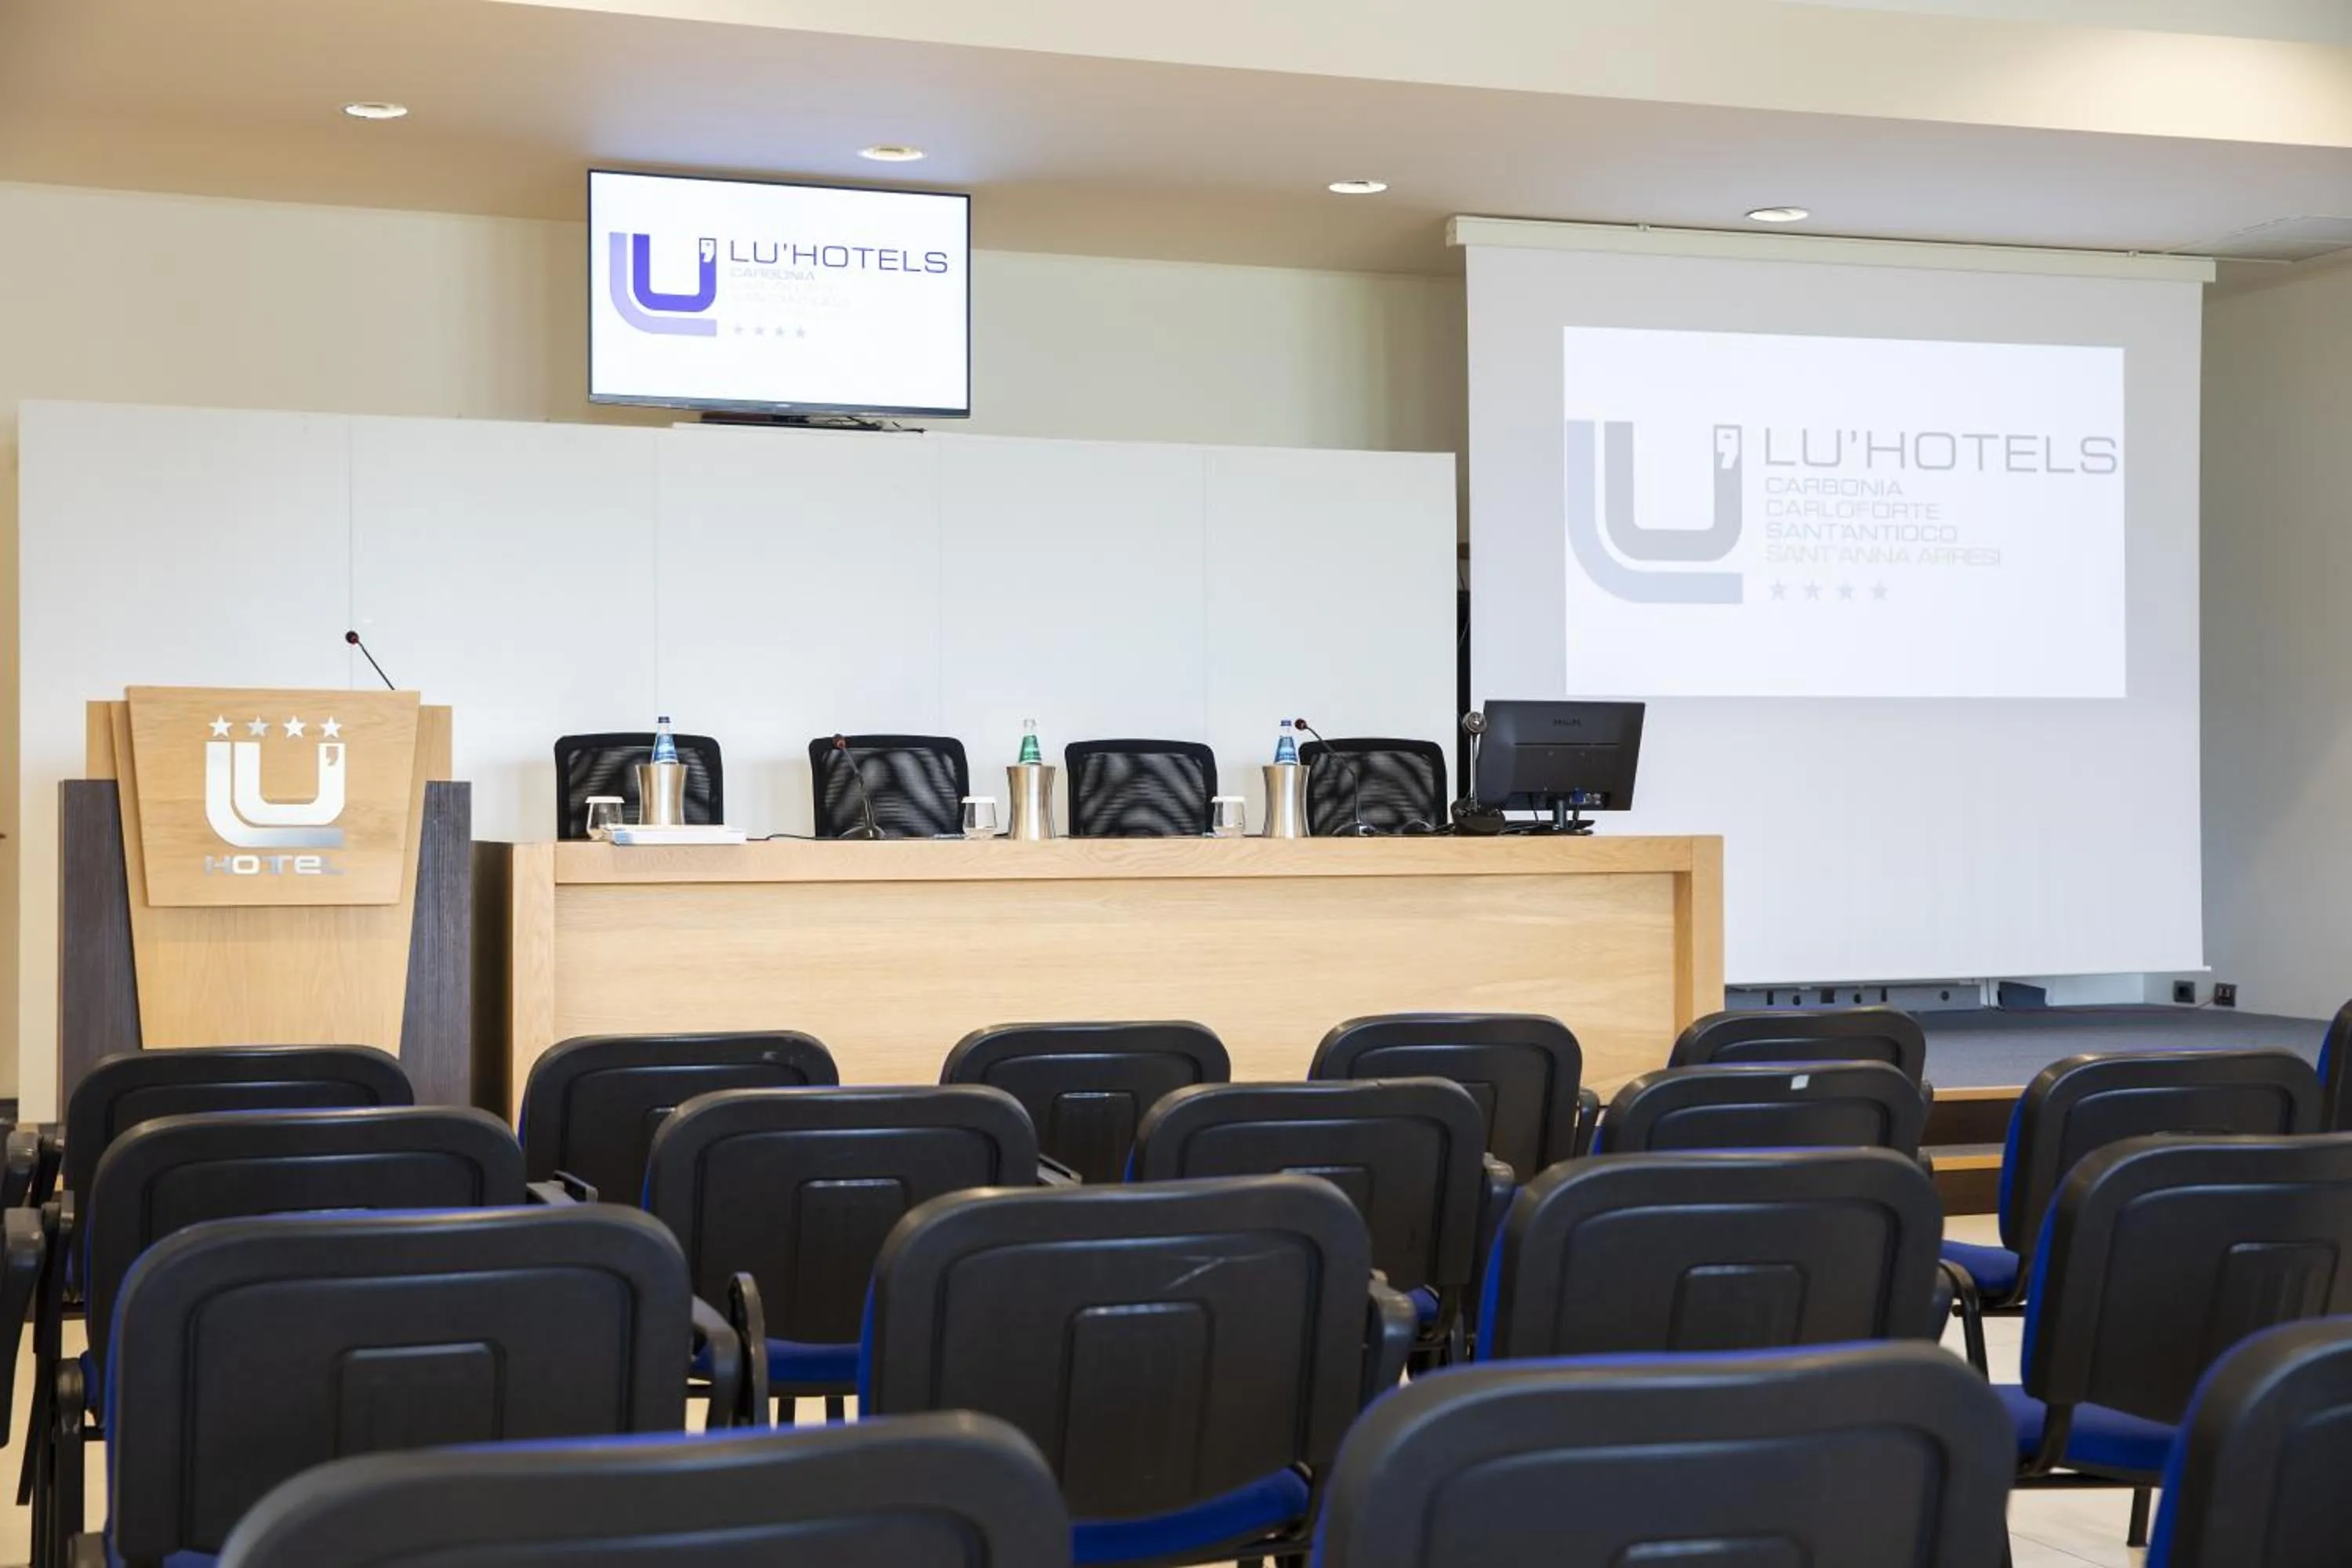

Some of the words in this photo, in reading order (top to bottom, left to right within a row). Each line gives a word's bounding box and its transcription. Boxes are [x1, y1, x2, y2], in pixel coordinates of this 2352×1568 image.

[730, 240, 948, 273] LU'HOTELS
[1765, 427, 2118, 474] LU'HOTELS
[1765, 477, 1904, 497] CARBONIA
[1765, 499, 1942, 520] CARLOFORTE
[1765, 521, 1958, 543] SANT'ANTIOCO
[1916, 546, 2002, 567] ARRESI
